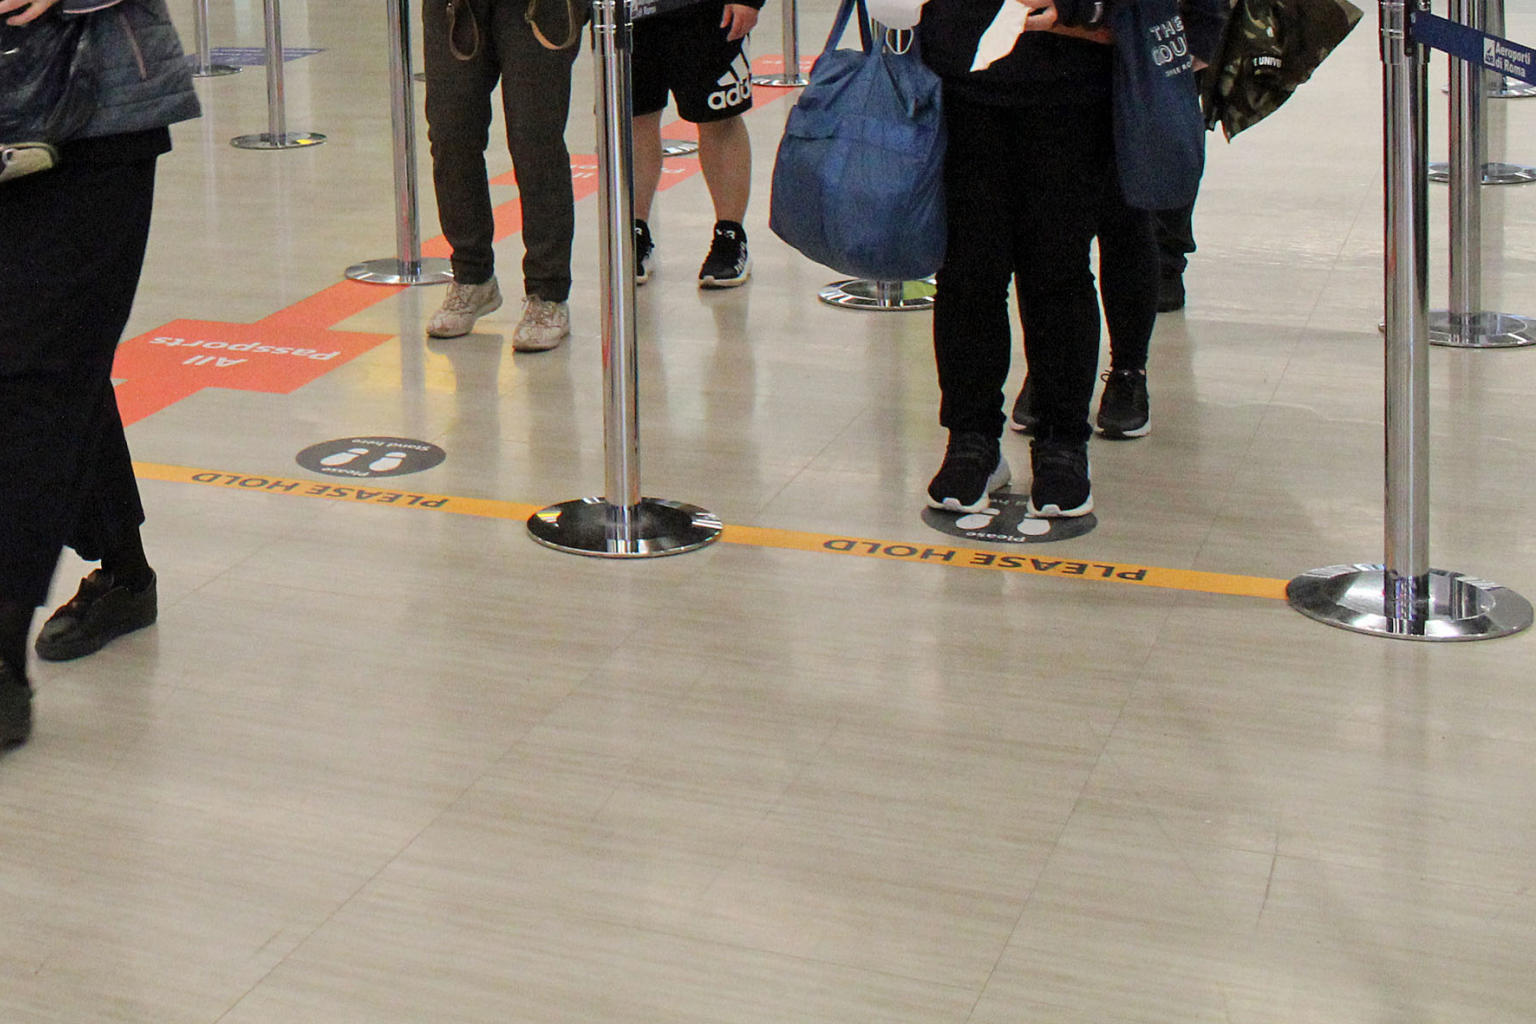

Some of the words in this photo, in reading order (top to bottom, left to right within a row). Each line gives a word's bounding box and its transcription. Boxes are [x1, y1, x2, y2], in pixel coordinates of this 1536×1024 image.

[1496, 41, 1531, 65] Aeroporti
[1504, 59, 1526, 78] Roma
[149, 336, 341, 361] Passports
[182, 355, 248, 367] All
[352, 438, 384, 447] here
[386, 439, 432, 451] Stand
[192, 472, 300, 493] HOLD
[321, 468, 369, 477] Please
[305, 484, 449, 509] PLEASE
[965, 531, 1026, 543] Please
[822, 539, 957, 562] HOLD
[970, 552, 1149, 582] PLEASE
